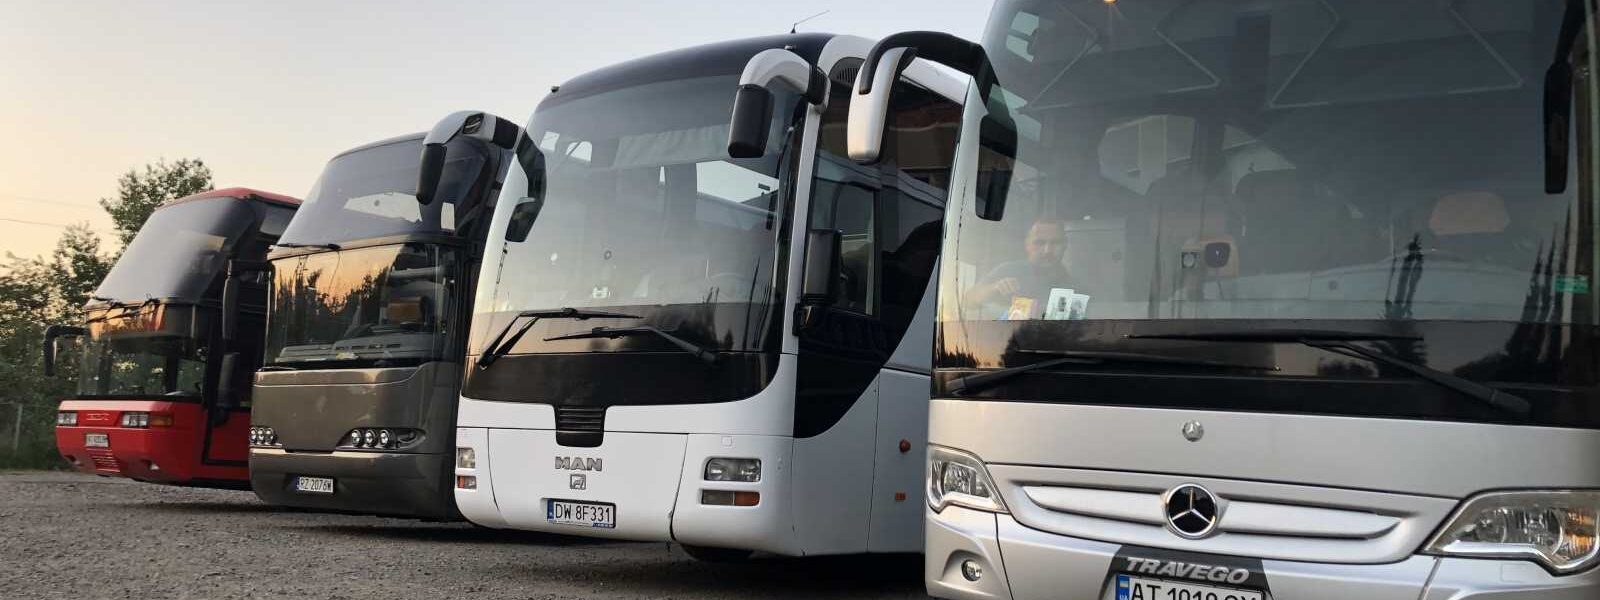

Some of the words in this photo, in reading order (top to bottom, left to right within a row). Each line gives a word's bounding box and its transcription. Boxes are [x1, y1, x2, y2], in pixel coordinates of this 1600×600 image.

[554, 456, 603, 472] MAN
[555, 503, 572, 520] DW
[575, 505, 610, 522] 8F331
[1126, 556, 1250, 585] TRAVEGO
[1131, 583, 1162, 600] AT
